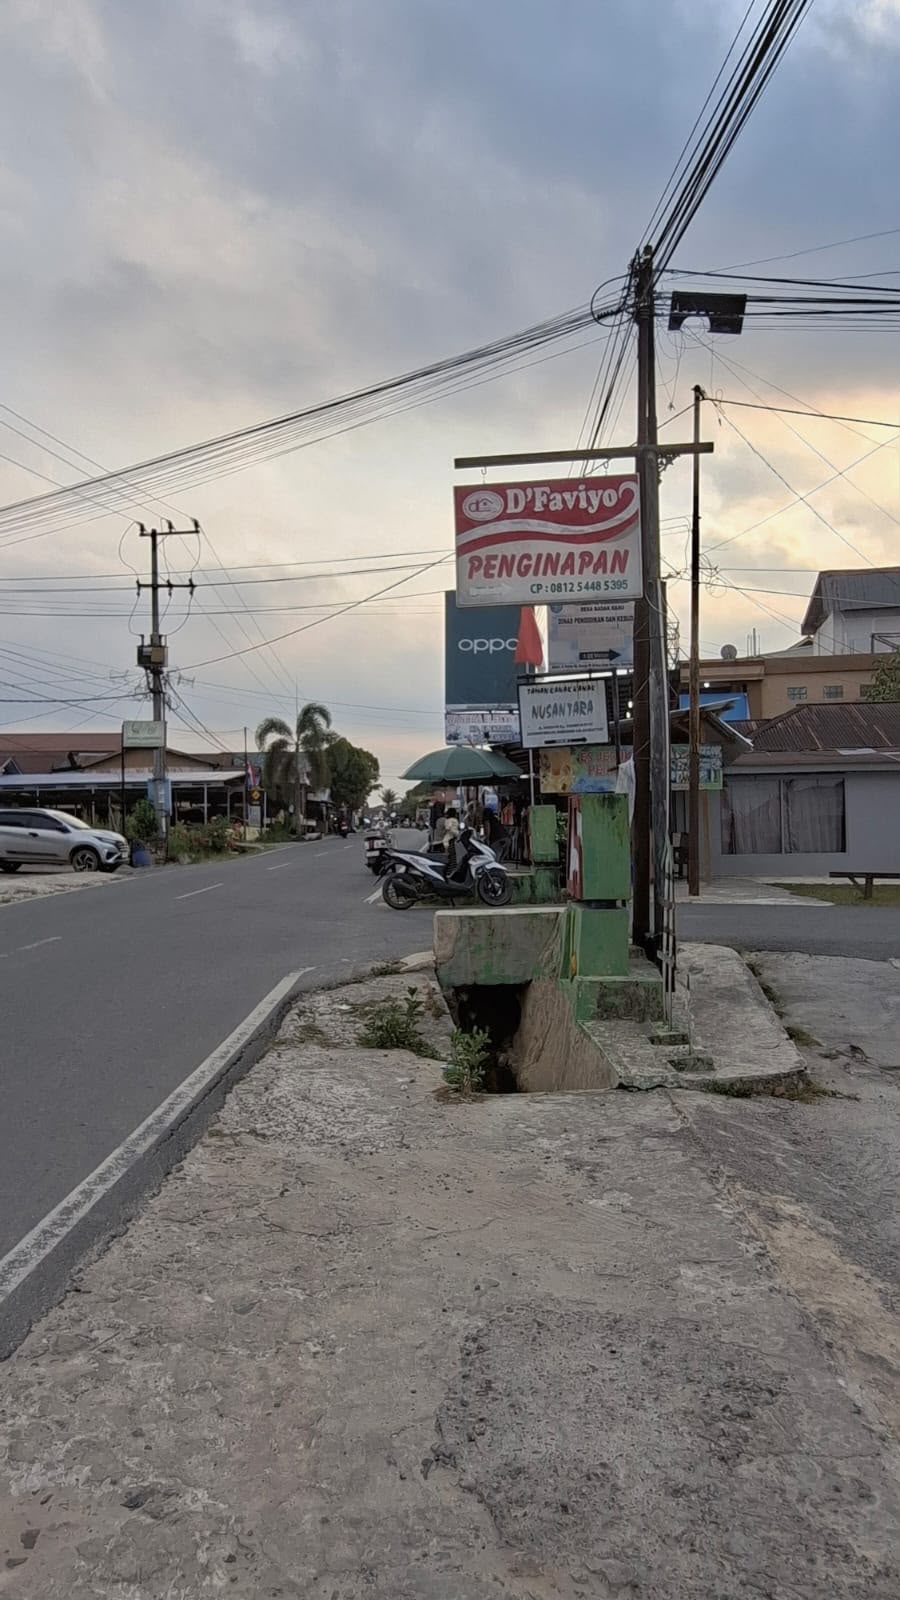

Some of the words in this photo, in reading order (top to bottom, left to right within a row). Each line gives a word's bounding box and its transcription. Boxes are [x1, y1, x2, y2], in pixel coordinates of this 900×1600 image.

[505, 484, 618, 514] D'Faviyo
[467, 550, 629, 579] PENGINAPAN
[550, 582, 575, 593] 0812
[576, 580, 602, 592] 5448
[603, 579, 629, 591] 5395
[531, 699, 594, 720] NUSANTARA
